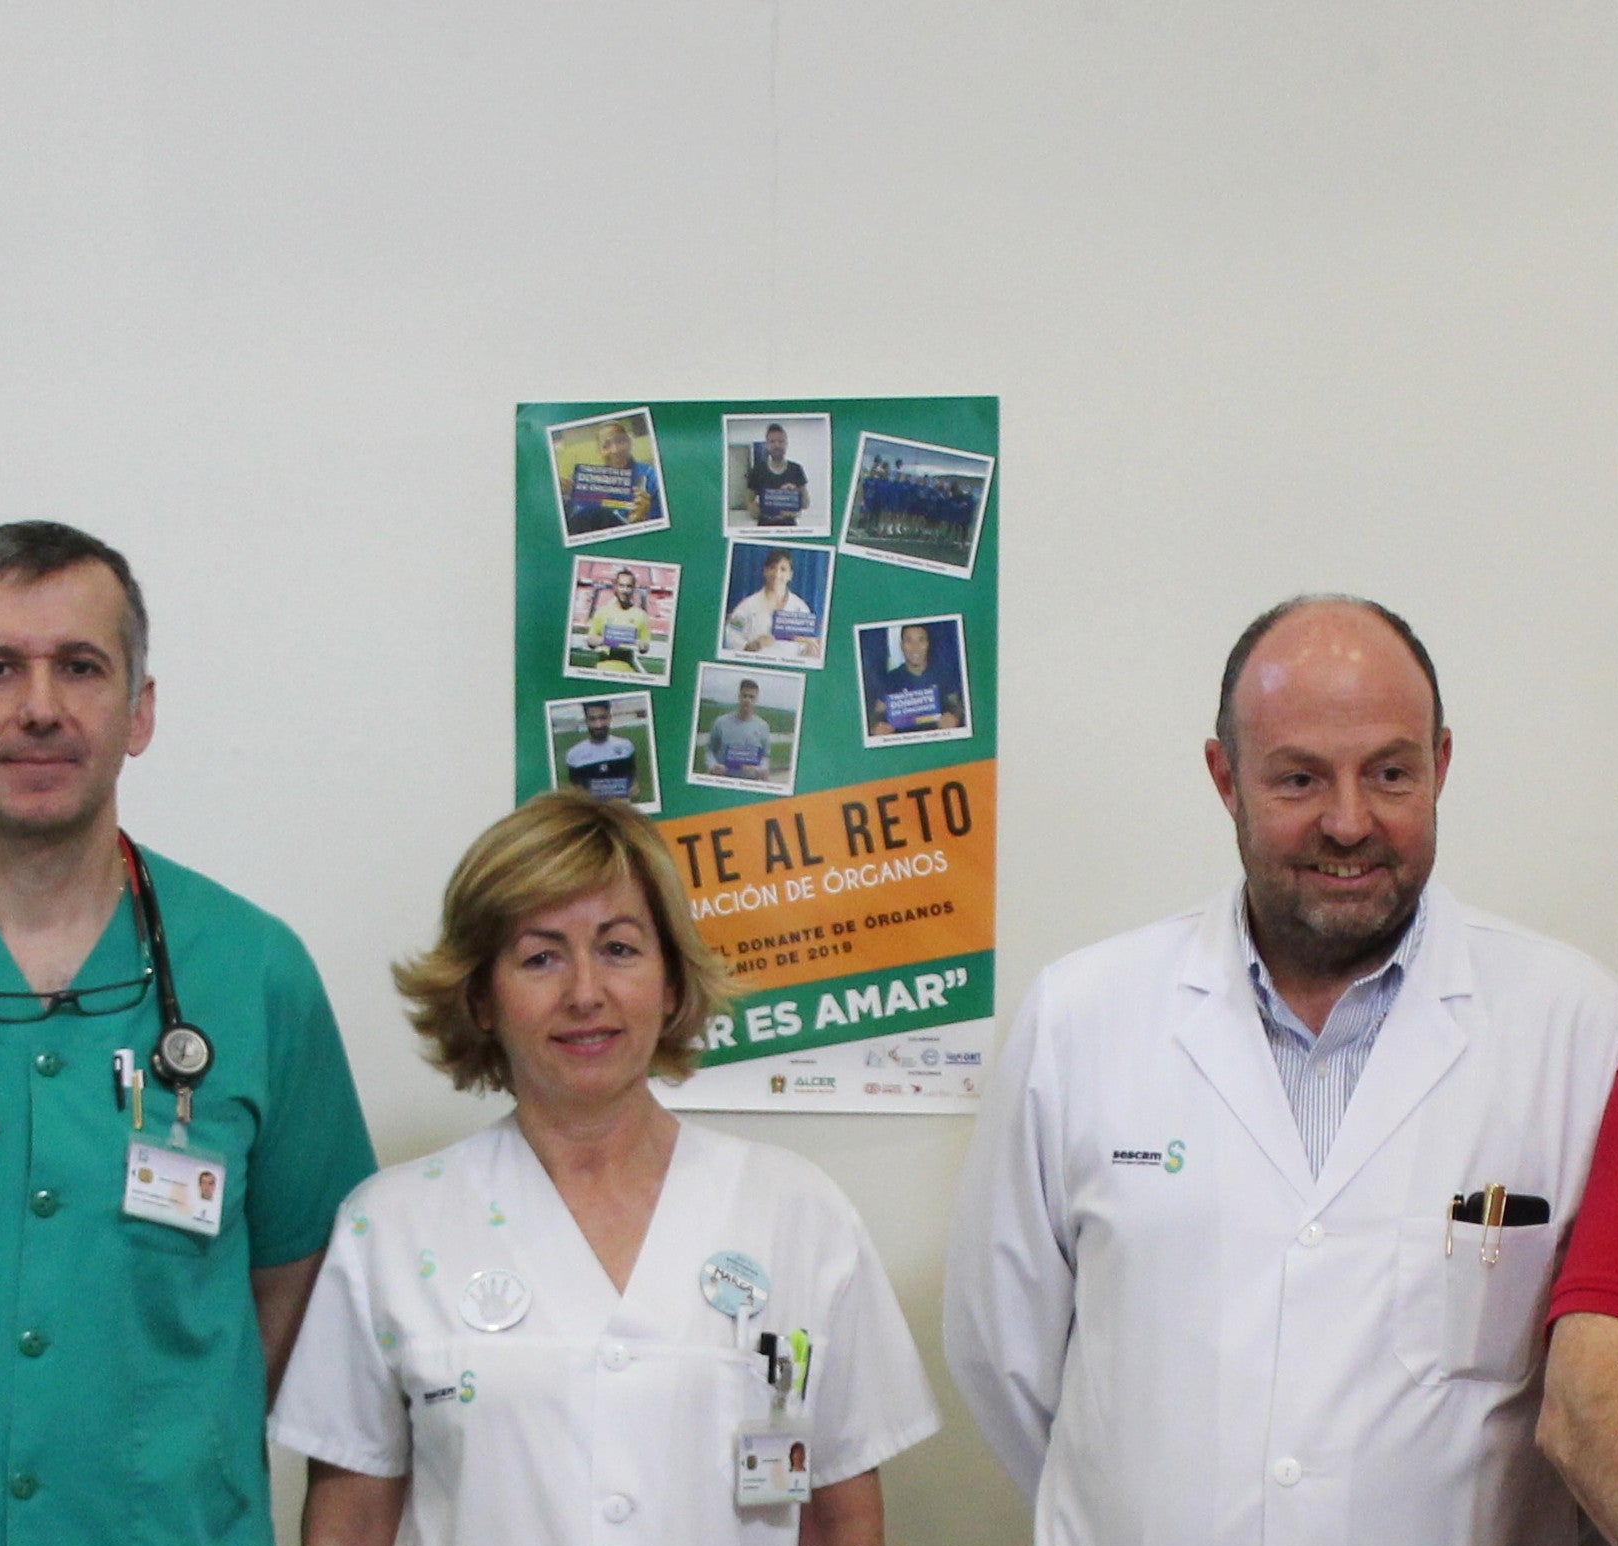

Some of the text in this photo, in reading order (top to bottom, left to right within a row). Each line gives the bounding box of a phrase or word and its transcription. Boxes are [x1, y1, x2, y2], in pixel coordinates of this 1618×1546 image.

[764, 811, 824, 874] AL
[841, 780, 972, 858] RETO
[691, 850, 948, 920] ACIÓN DE ÓRGANOS
[738, 901, 954, 954] DONANTE DE ÓRGANOS
[727, 957, 767, 977] NIO
[776, 951, 799, 967] DE
[745, 1000, 802, 1042] ES
